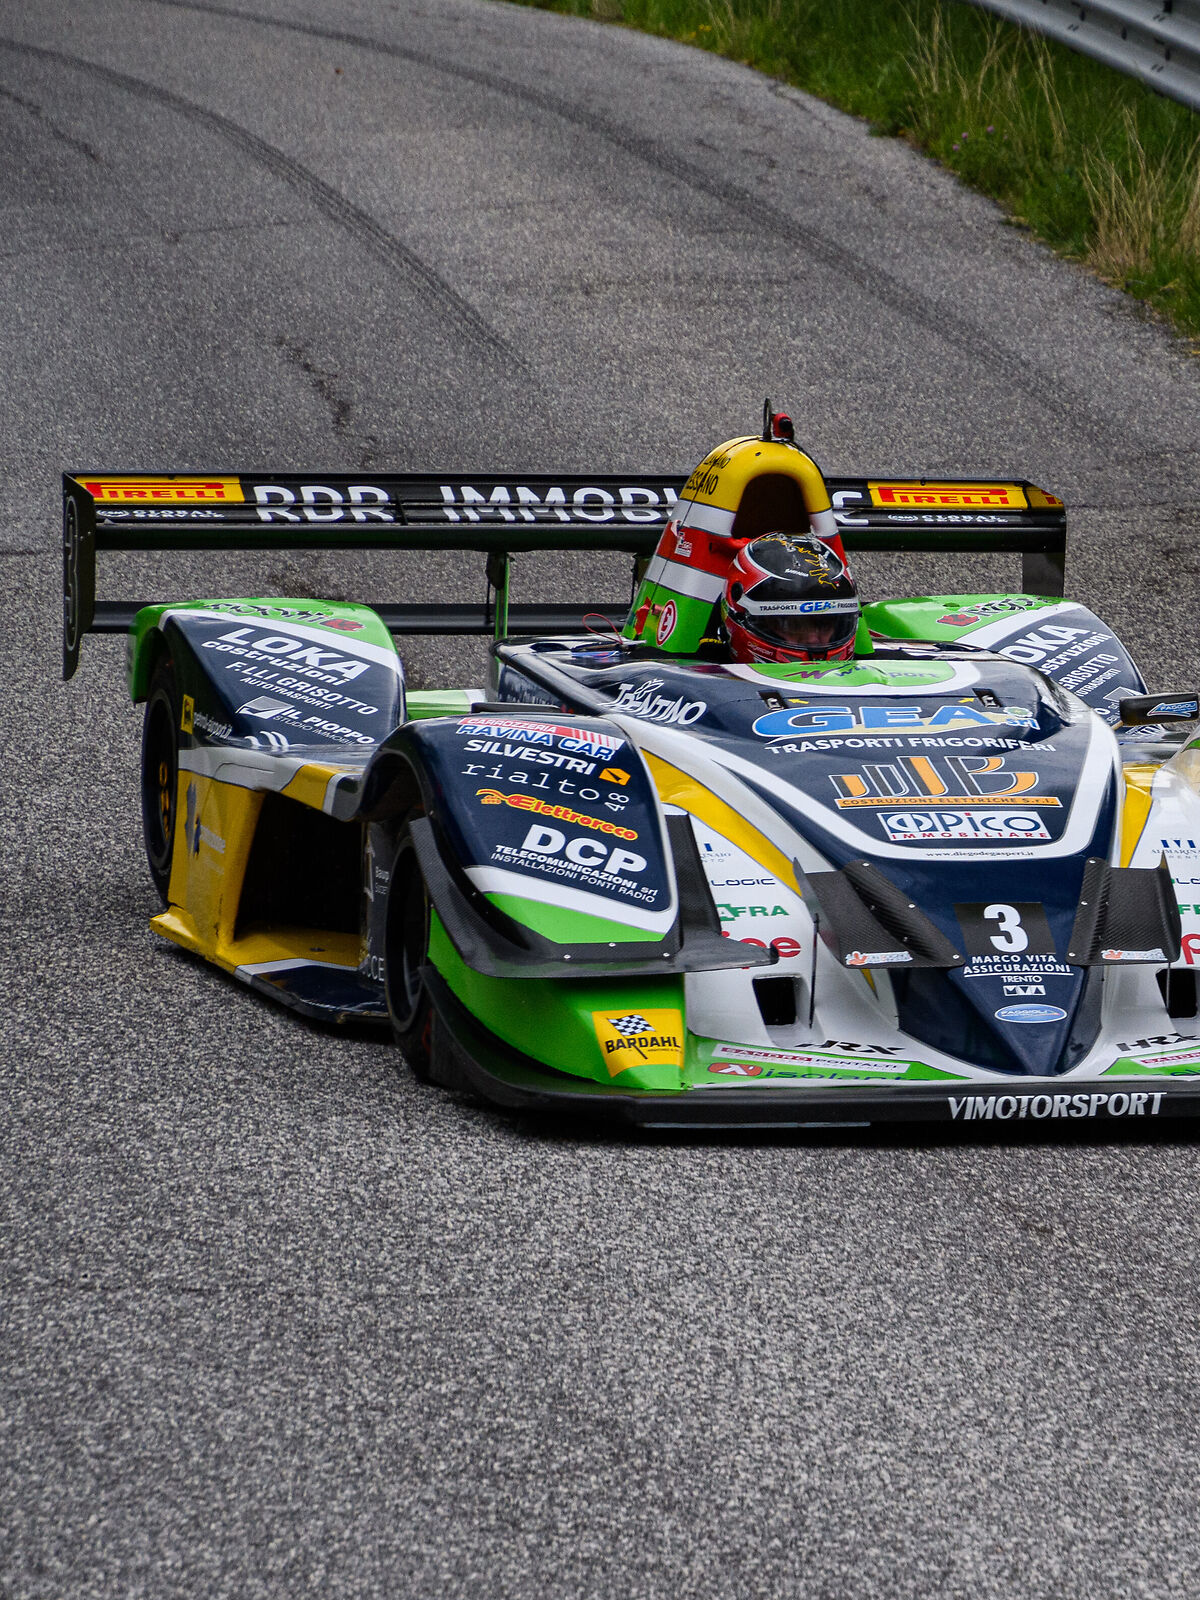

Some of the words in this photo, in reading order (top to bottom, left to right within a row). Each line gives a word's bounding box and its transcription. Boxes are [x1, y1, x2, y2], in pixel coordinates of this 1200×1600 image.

[85, 482, 226, 499] PIRELLI
[253, 485, 395, 522] RDR
[878, 487, 1010, 505] PIRELLI
[201, 640, 351, 686] costruzioni
[216, 628, 371, 680] LOKA
[225, 660, 280, 681] F.LLI
[276, 676, 379, 715] GRISOTTO
[241, 676, 335, 710] AUTOTRASPORTI
[280, 708, 303, 720] IL
[302, 716, 376, 744] PIOPPO
[466, 718, 557, 734] CARROZZERIA
[752, 705, 1000, 738] GEA
[456, 724, 554, 746] RAVINA
[558, 737, 616, 761] CAR
[463, 739, 597, 776] SILVESTRI
[766, 737, 904, 755] TRASPORTI
[910, 736, 1057, 753] FRIGORIFERI
[461, 762, 600, 801] rialto
[842, 797, 934, 806] COSTRUZIONI
[937, 797, 1018, 805] ELETTRICHE
[520, 824, 648, 875] DCP
[891, 832, 1049, 840] IMMOBILIARE
[491, 852, 578, 880] INSTALLAZIONI
[579, 872, 616, 894] PONTI
[617, 887, 656, 903] RADIO
[495, 844, 637, 889] TELECOMUNICAZIONI
[640, 885, 658, 896] srl
[983, 904, 1029, 953] 3
[963, 963, 1071, 975] ASSICURAZIONI
[971, 955, 1021, 965] MARCO
[1025, 954, 1057, 964] VITA
[1000, 975, 1043, 983] TRENTO
[605, 1036, 682, 1054] BARDAHL
[947, 1092, 1168, 1120] VIMOTORSPORT
